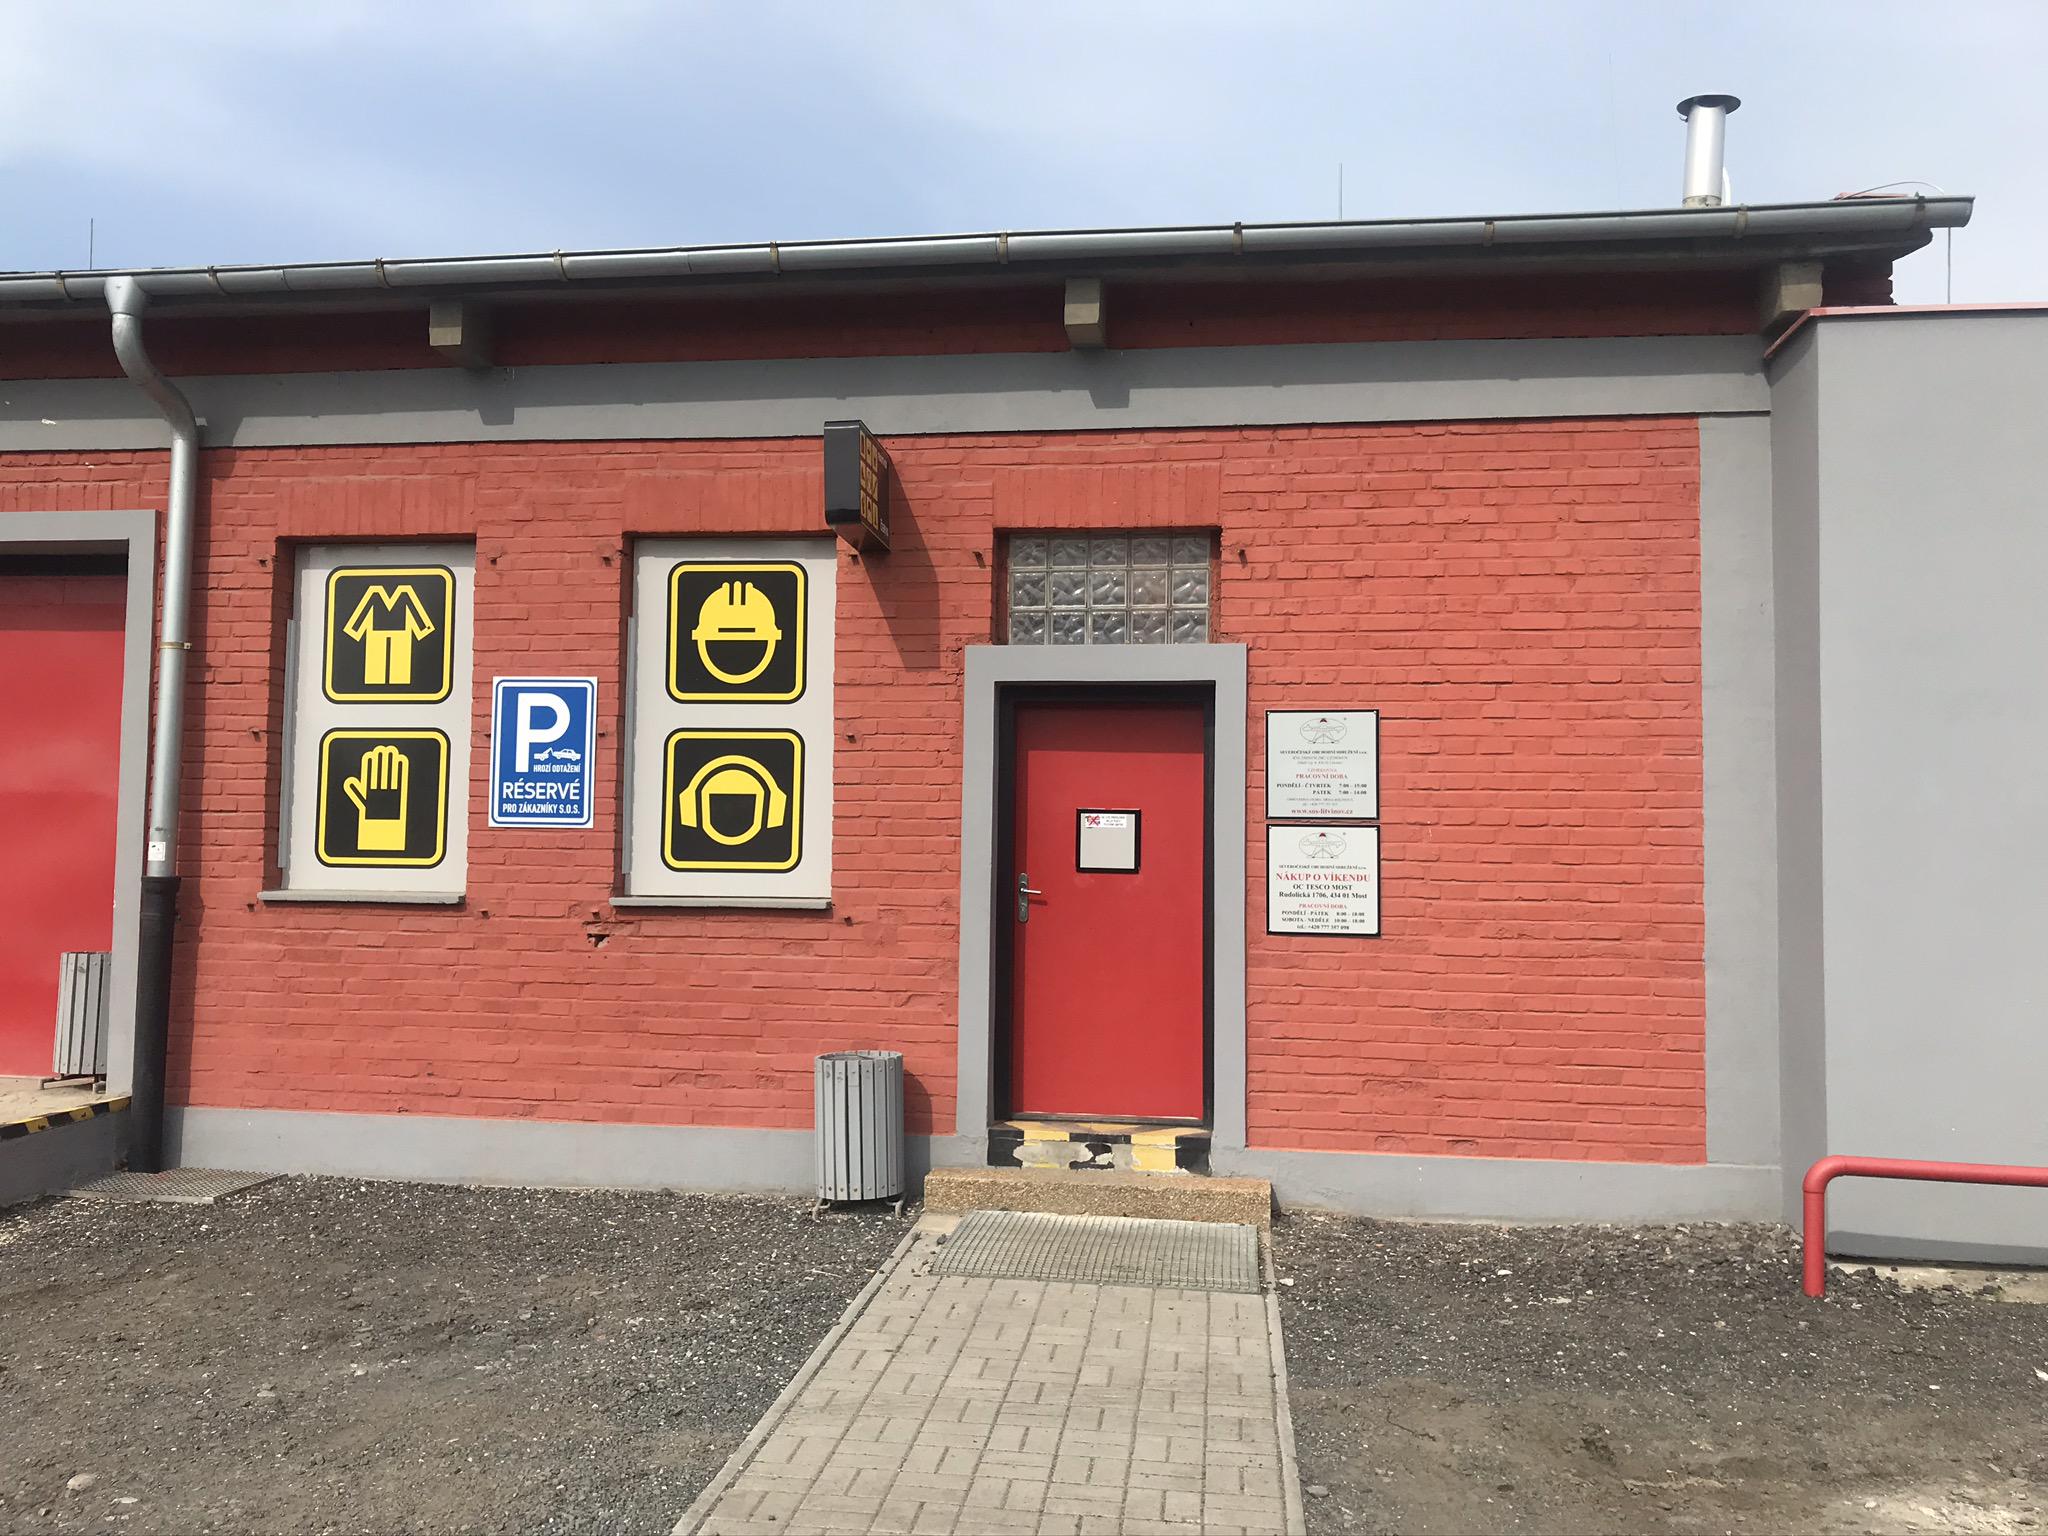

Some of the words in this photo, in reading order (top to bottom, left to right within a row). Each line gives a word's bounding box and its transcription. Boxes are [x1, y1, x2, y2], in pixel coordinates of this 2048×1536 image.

[516, 693, 571, 773] P
[534, 762, 551, 773] HROZÍ
[552, 763, 581, 773] ODTAŽENÍ
[503, 778, 580, 800] RÉSERVÉ
[503, 803, 517, 813] PRO
[519, 802, 558, 814] ZÁKAZNÍKY
[559, 804, 580, 814] S.O.S.
[1277, 871, 1311, 881] NÁKUP
[1324, 872, 1370, 882] VÍKENDU
